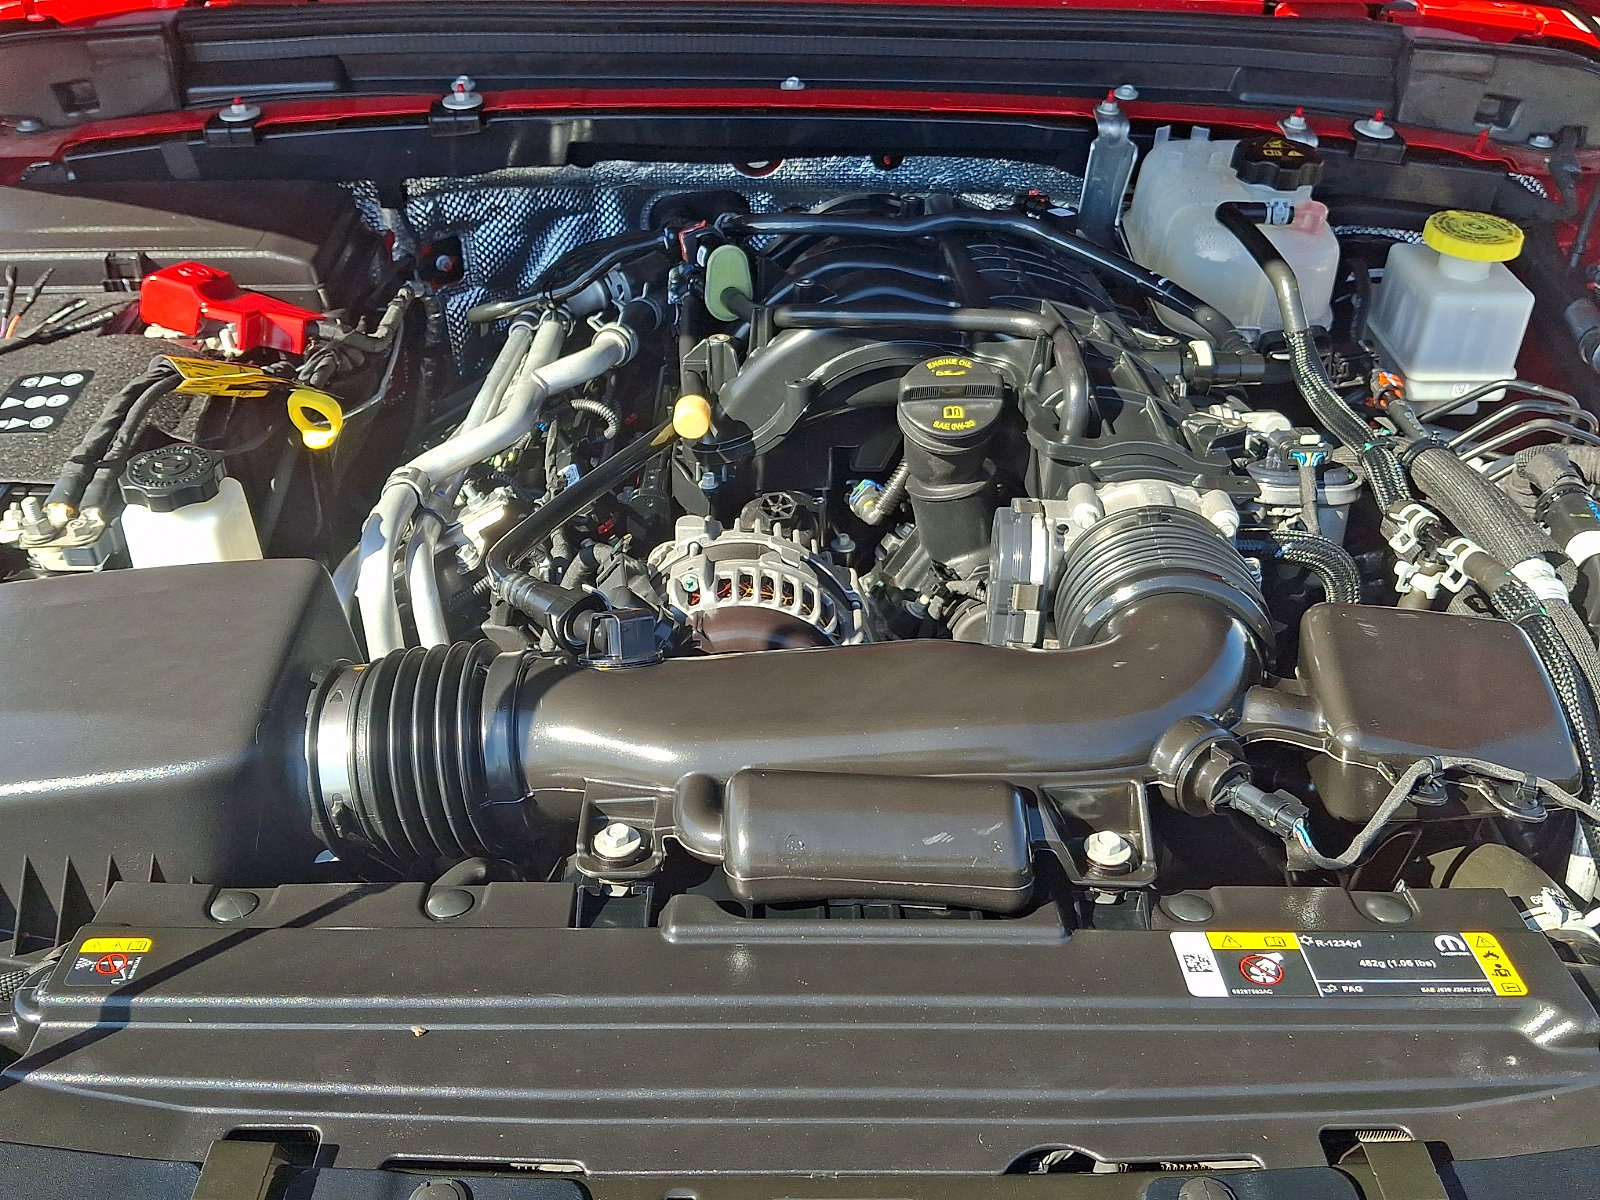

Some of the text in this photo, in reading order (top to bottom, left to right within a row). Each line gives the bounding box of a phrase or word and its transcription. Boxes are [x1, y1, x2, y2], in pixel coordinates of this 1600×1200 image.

[926, 358, 973, 370] ENGINE OIL
[932, 420, 976, 431] SAE 0W-20
[1314, 939, 1363, 949] R-1234yf
[1413, 959, 1437, 969] lbs)
[1341, 985, 1364, 993] PAG
